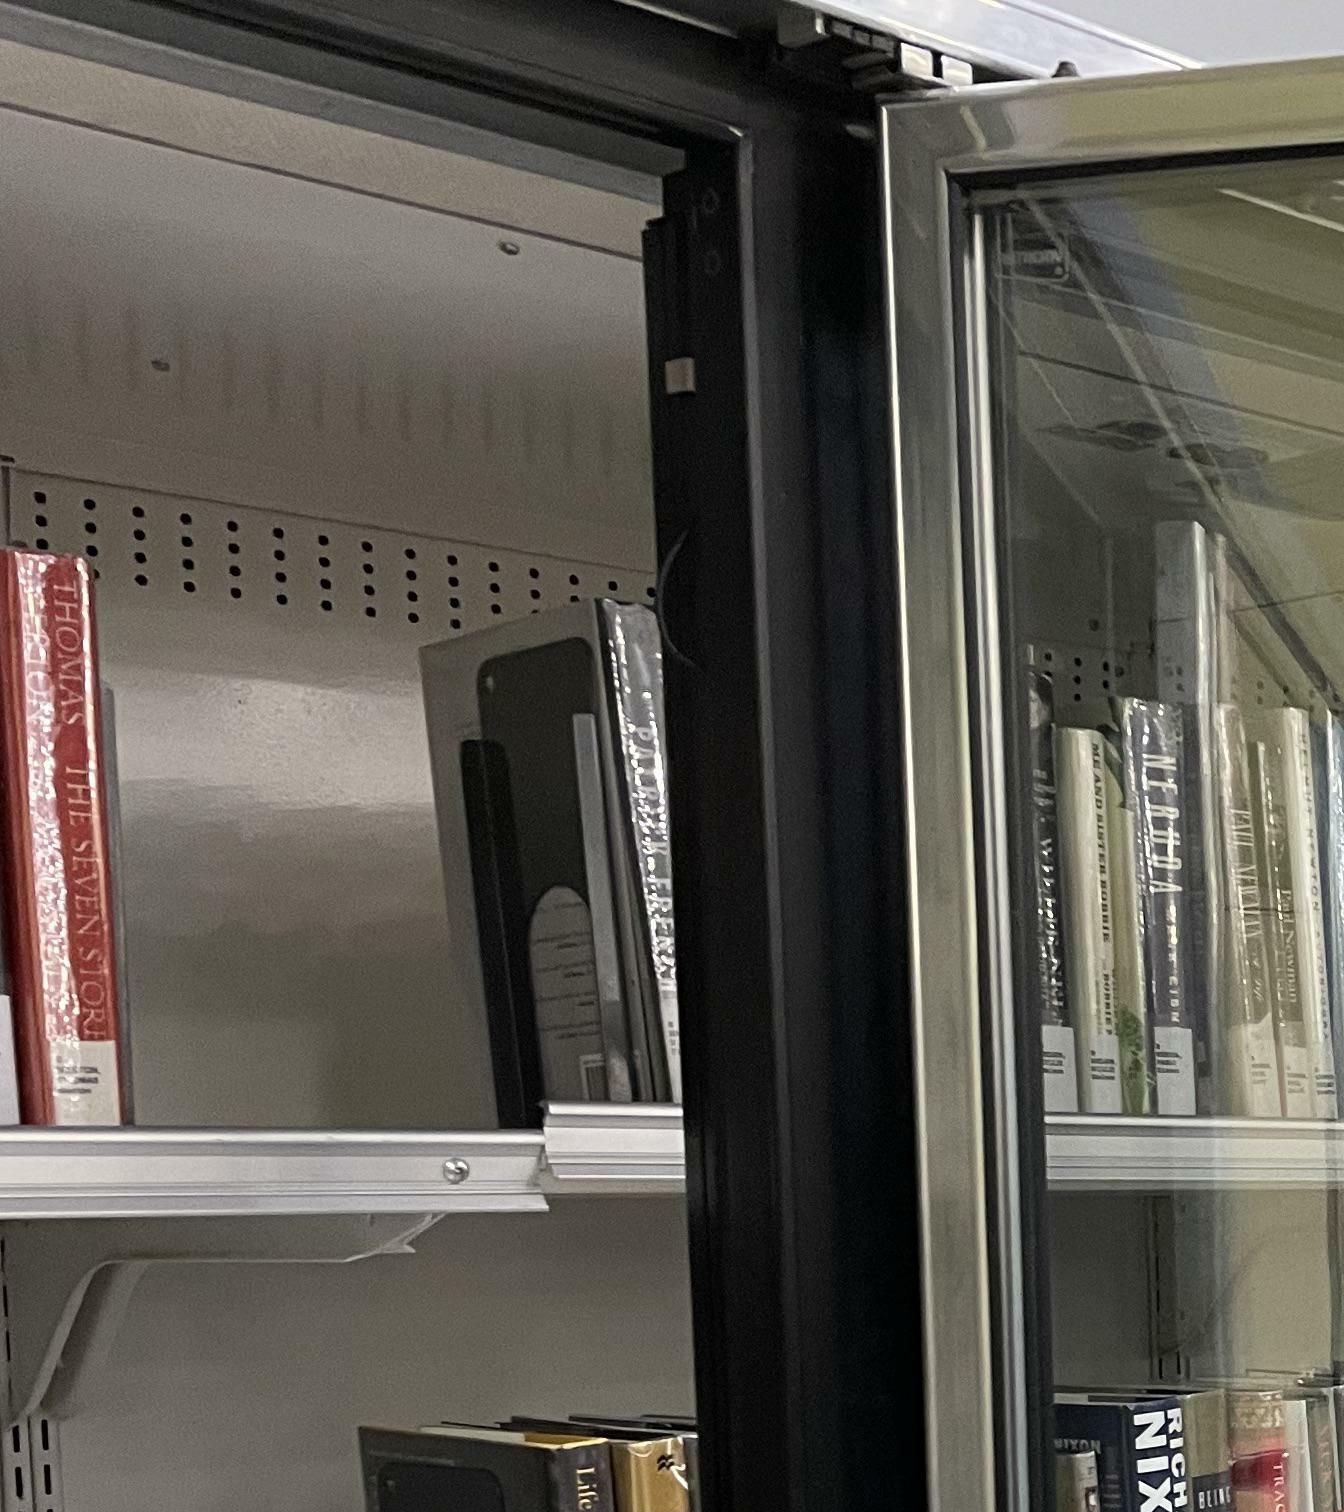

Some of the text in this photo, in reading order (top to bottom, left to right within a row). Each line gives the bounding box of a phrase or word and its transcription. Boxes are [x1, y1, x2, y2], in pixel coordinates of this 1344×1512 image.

[53, 581, 84, 725] THOMAS
[66, 765, 92, 826] THE
[1142, 753, 1183, 894] NERUDA
[71, 839, 102, 935] SEVEN
[1280, 889, 1297, 1004] Paul Newman
[575, 1467, 600, 1510] Life
